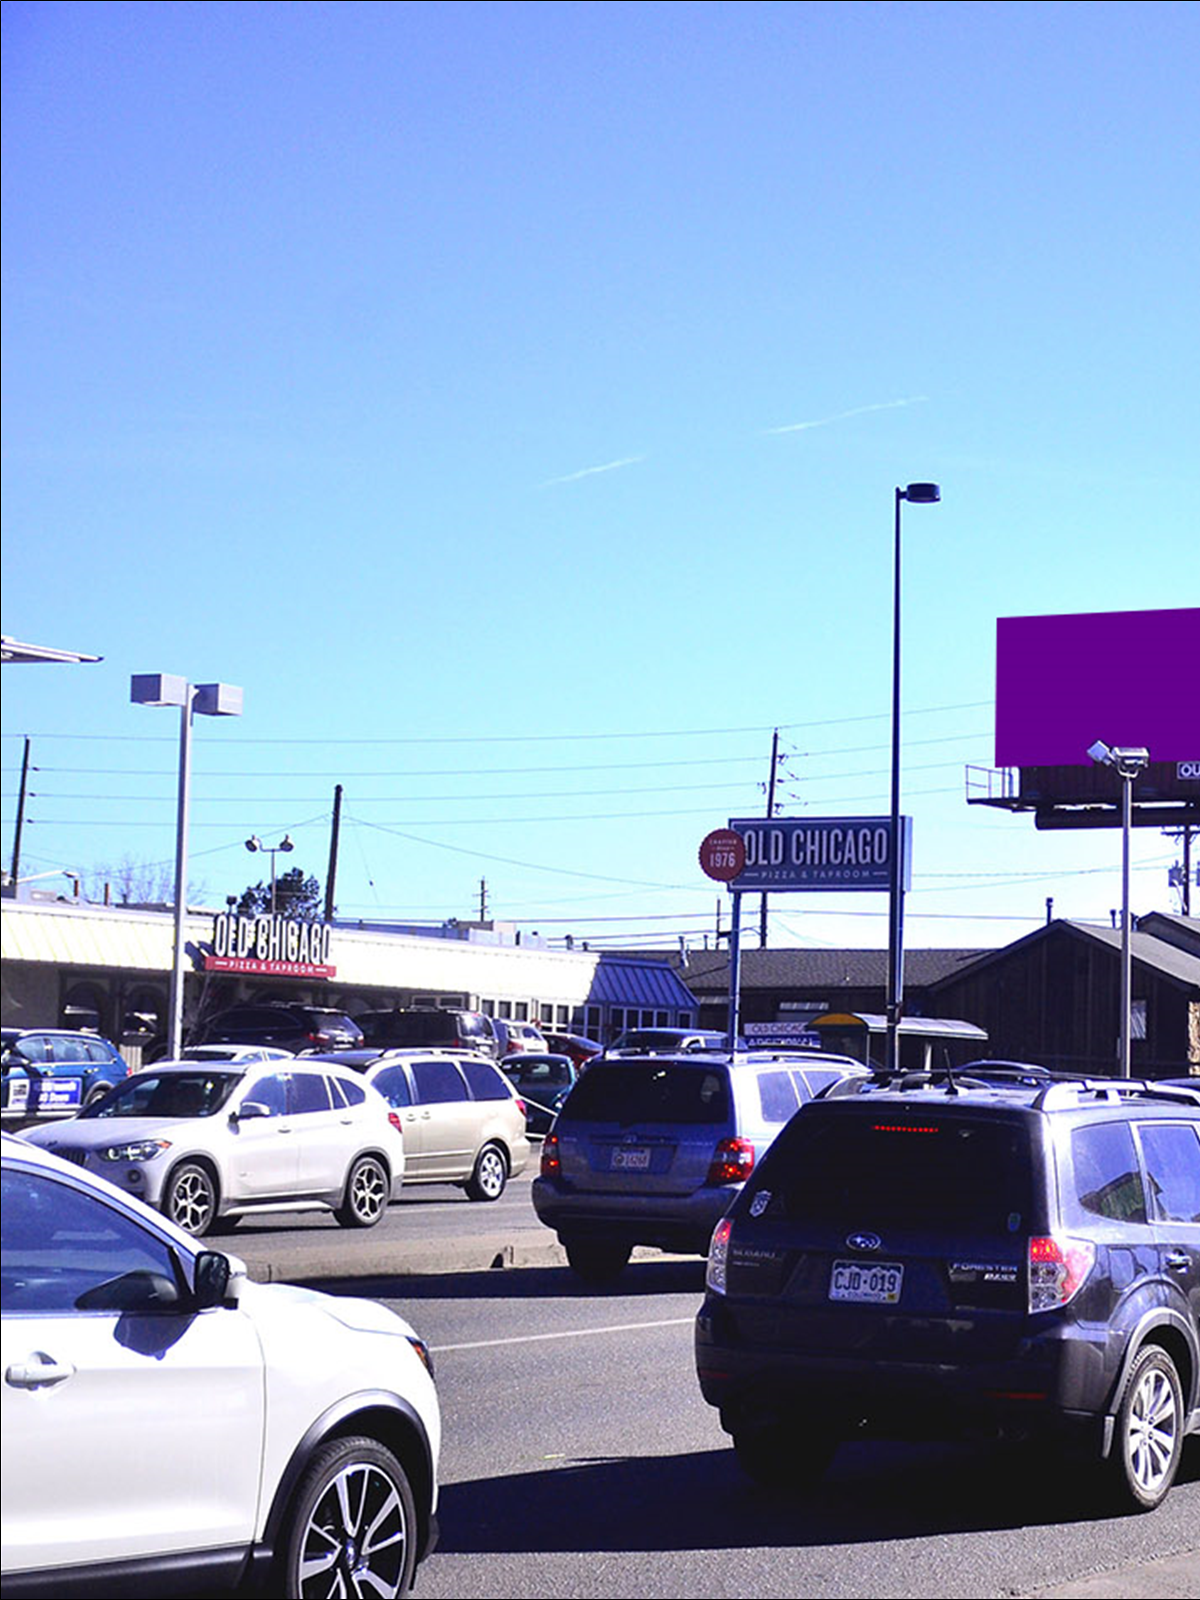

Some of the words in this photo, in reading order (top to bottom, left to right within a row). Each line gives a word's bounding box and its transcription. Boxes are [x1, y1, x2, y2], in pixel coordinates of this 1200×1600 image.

[744, 829, 784, 865] OLD
[791, 828, 887, 865] CHICAGO
[710, 852, 736, 868] 1976
[761, 871, 796, 879] PIZZA
[813, 870, 870, 879] TAPROOM
[215, 914, 249, 958] OLD
[256, 915, 332, 966] CHICAGO
[229, 961, 257, 970] PIZZA
[270, 964, 314, 973] TAPROOM
